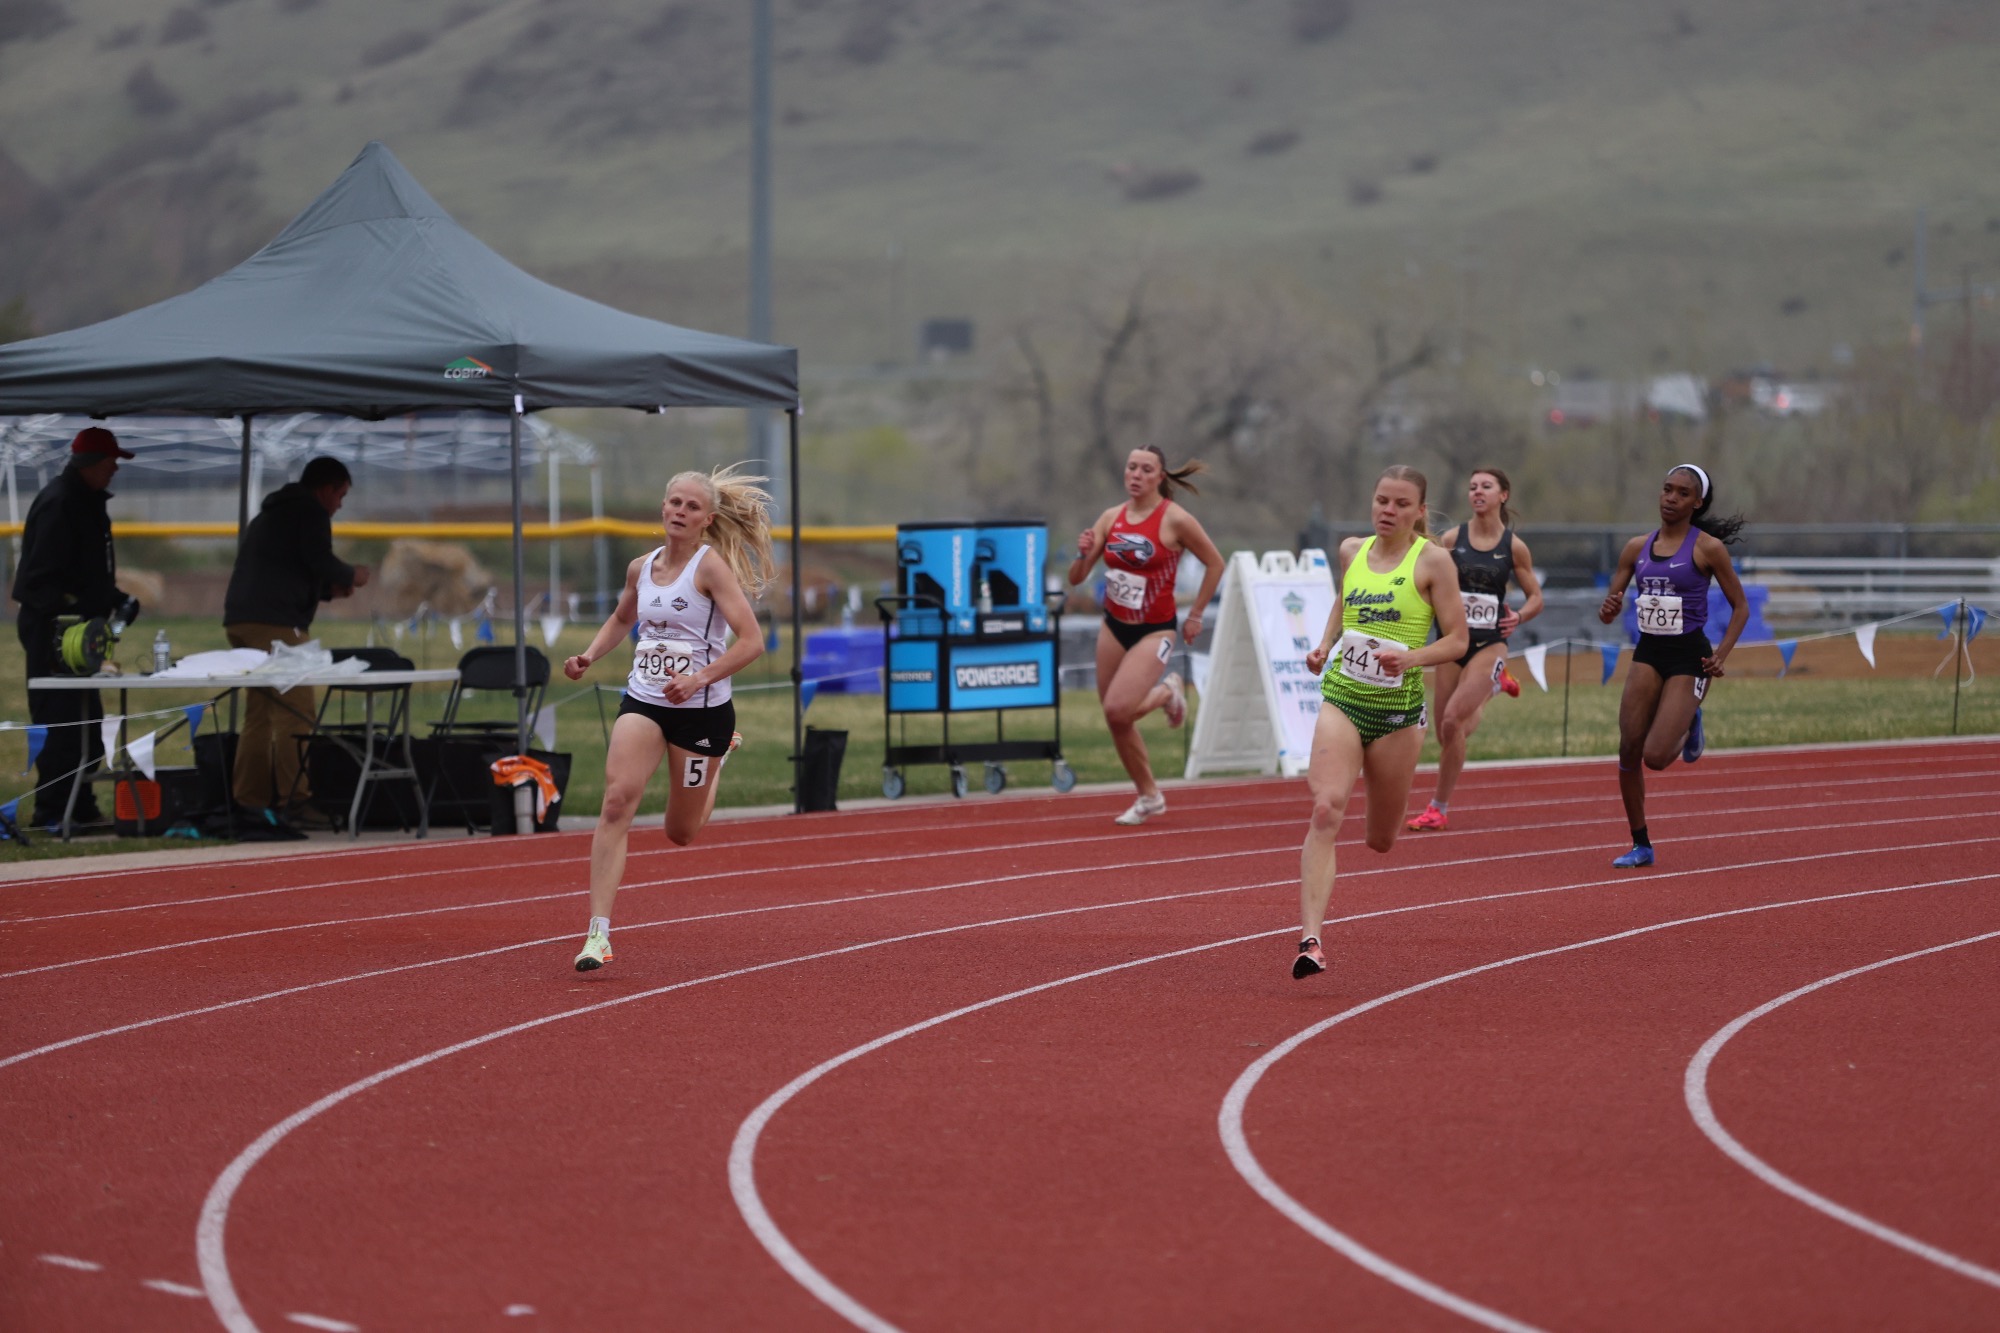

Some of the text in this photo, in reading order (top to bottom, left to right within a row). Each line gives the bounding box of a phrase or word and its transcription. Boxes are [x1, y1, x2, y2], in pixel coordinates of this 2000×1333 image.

[1109, 580, 1143, 601] 927
[1345, 587, 1395, 608] Adams
[1357, 606, 1401, 624] State
[1638, 605, 1680, 627] 4787
[1160, 639, 1171, 659] 7
[1292, 636, 1311, 651] NO
[637, 652, 691, 677] 4992
[955, 662, 1039, 688] POWERADE
[688, 759, 704, 787] 5
